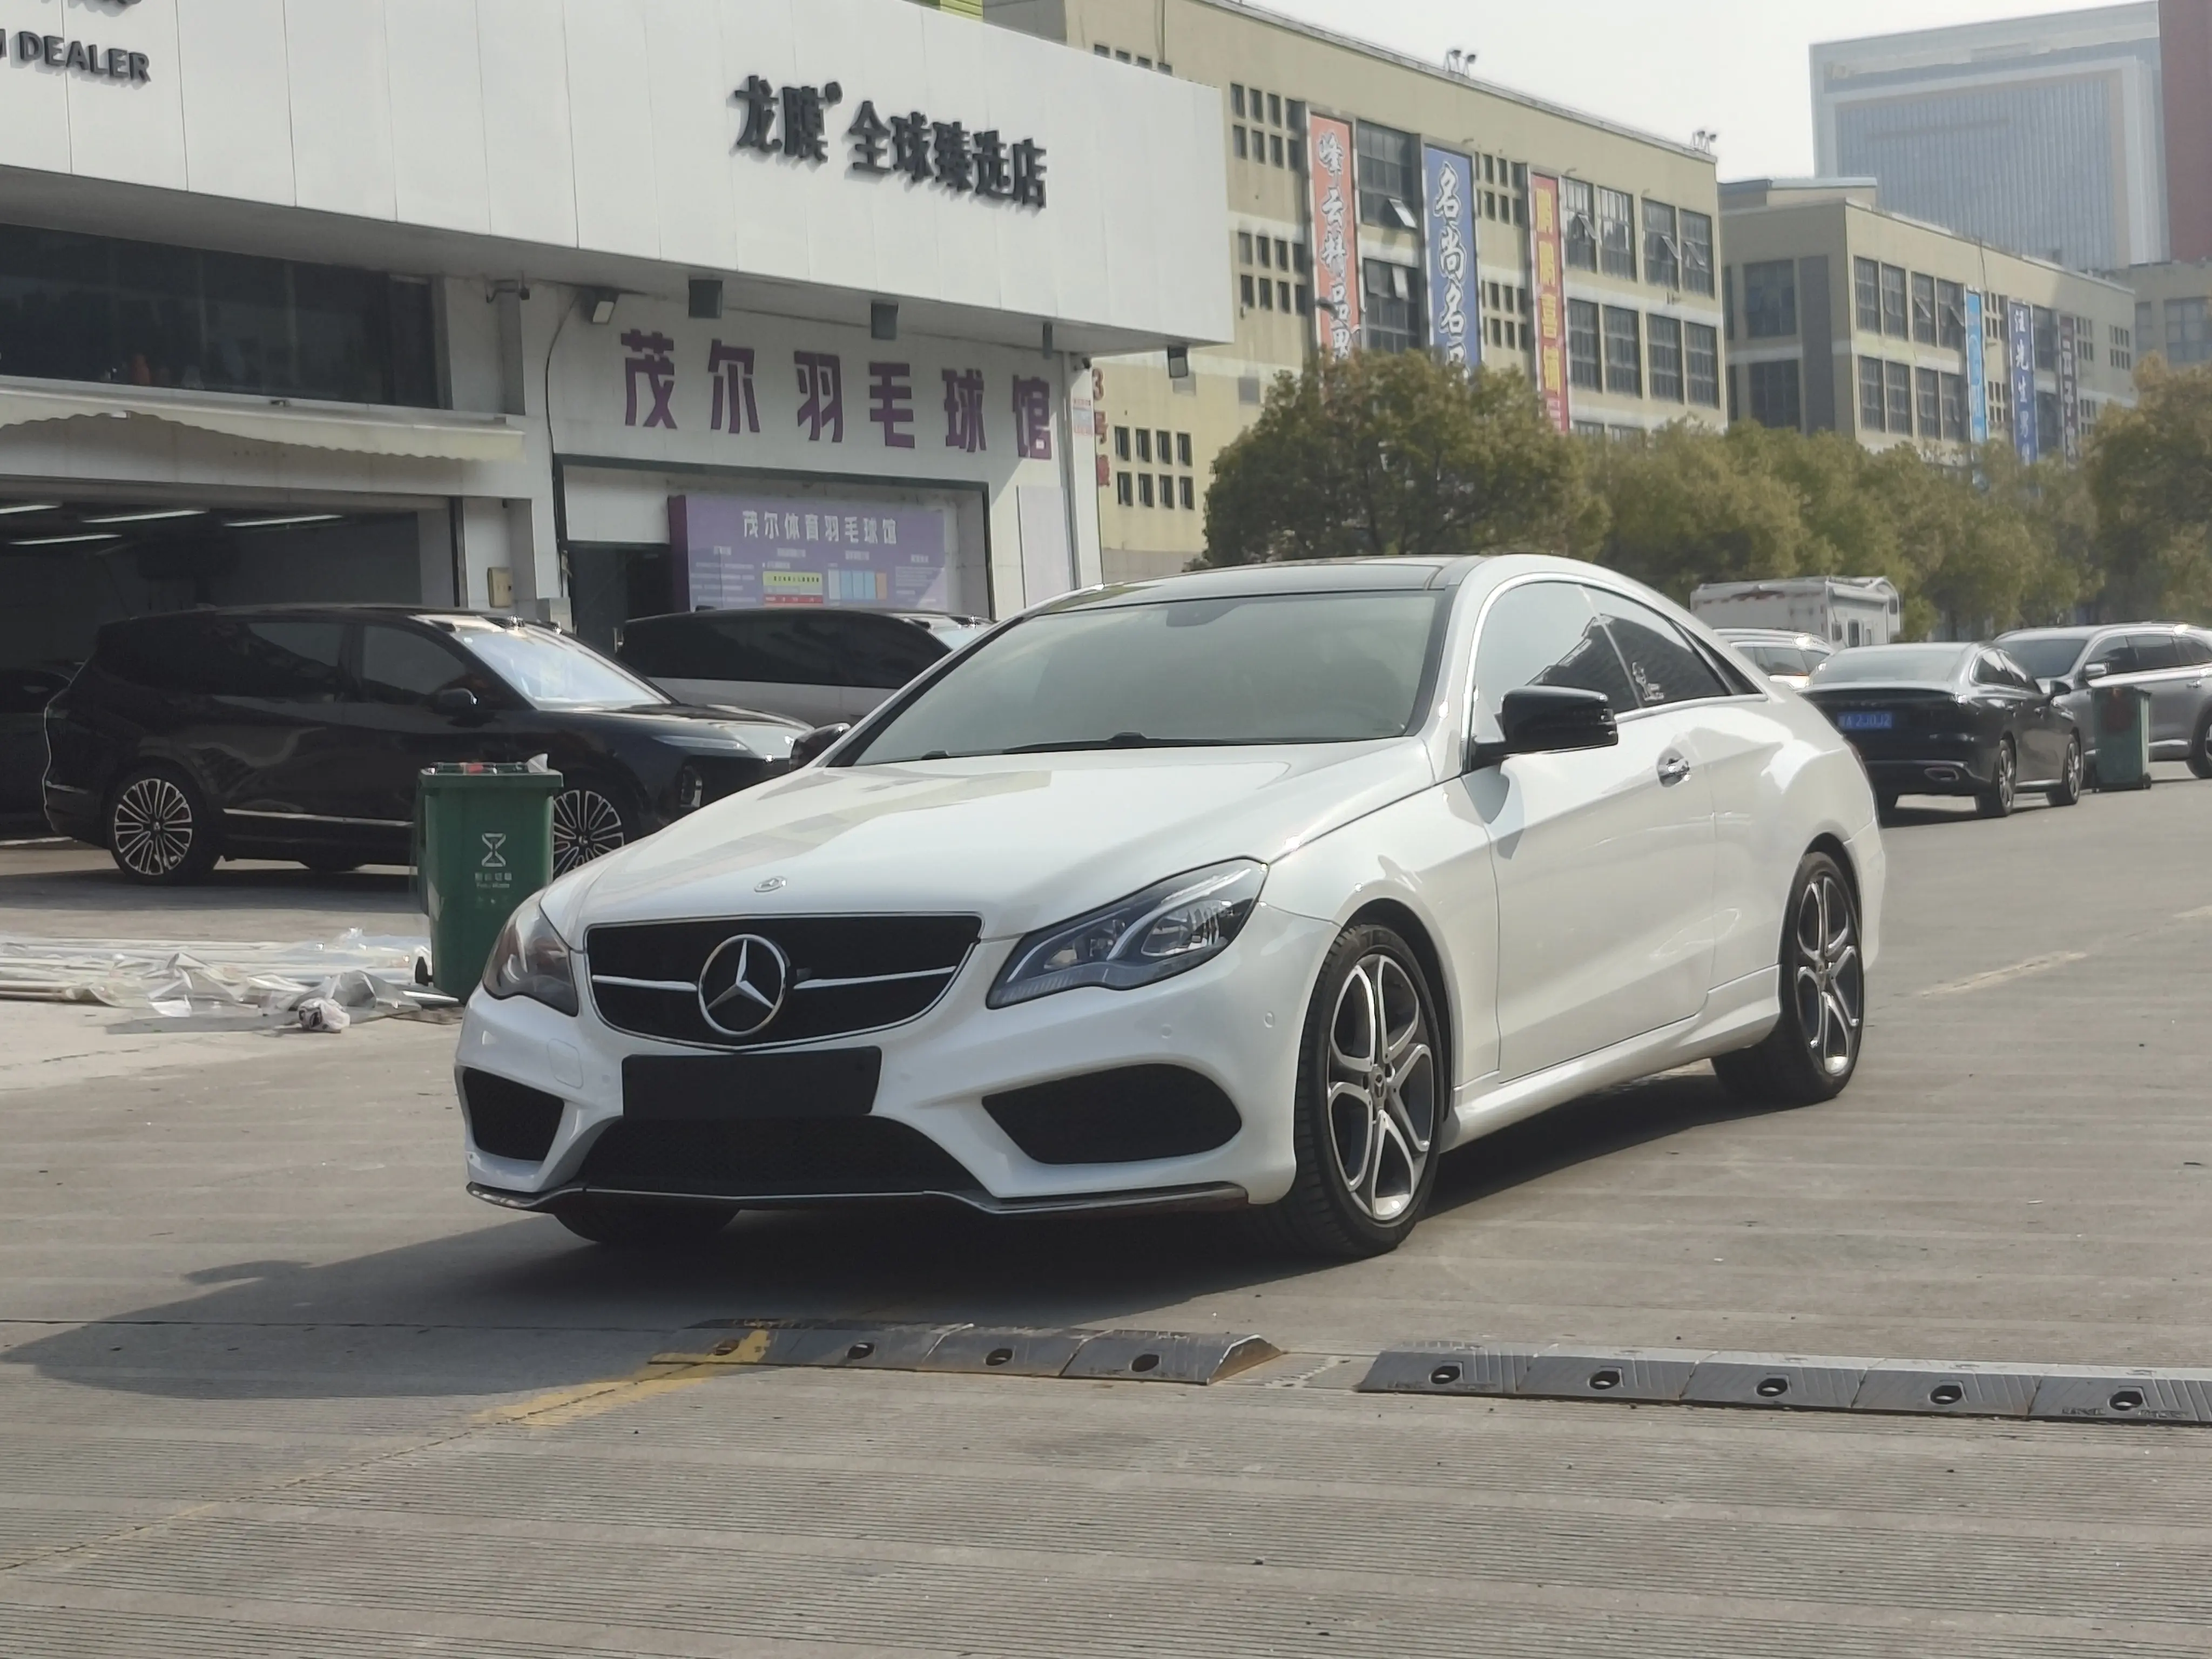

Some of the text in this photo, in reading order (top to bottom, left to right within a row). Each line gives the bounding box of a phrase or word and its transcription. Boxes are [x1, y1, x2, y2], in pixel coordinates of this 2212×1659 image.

[19, 31, 151, 83] DEALER
[621, 328, 1051, 460] 茂尔羽毛球馆
[743, 510, 896, 544] 茂尔体育羽毛球馆
